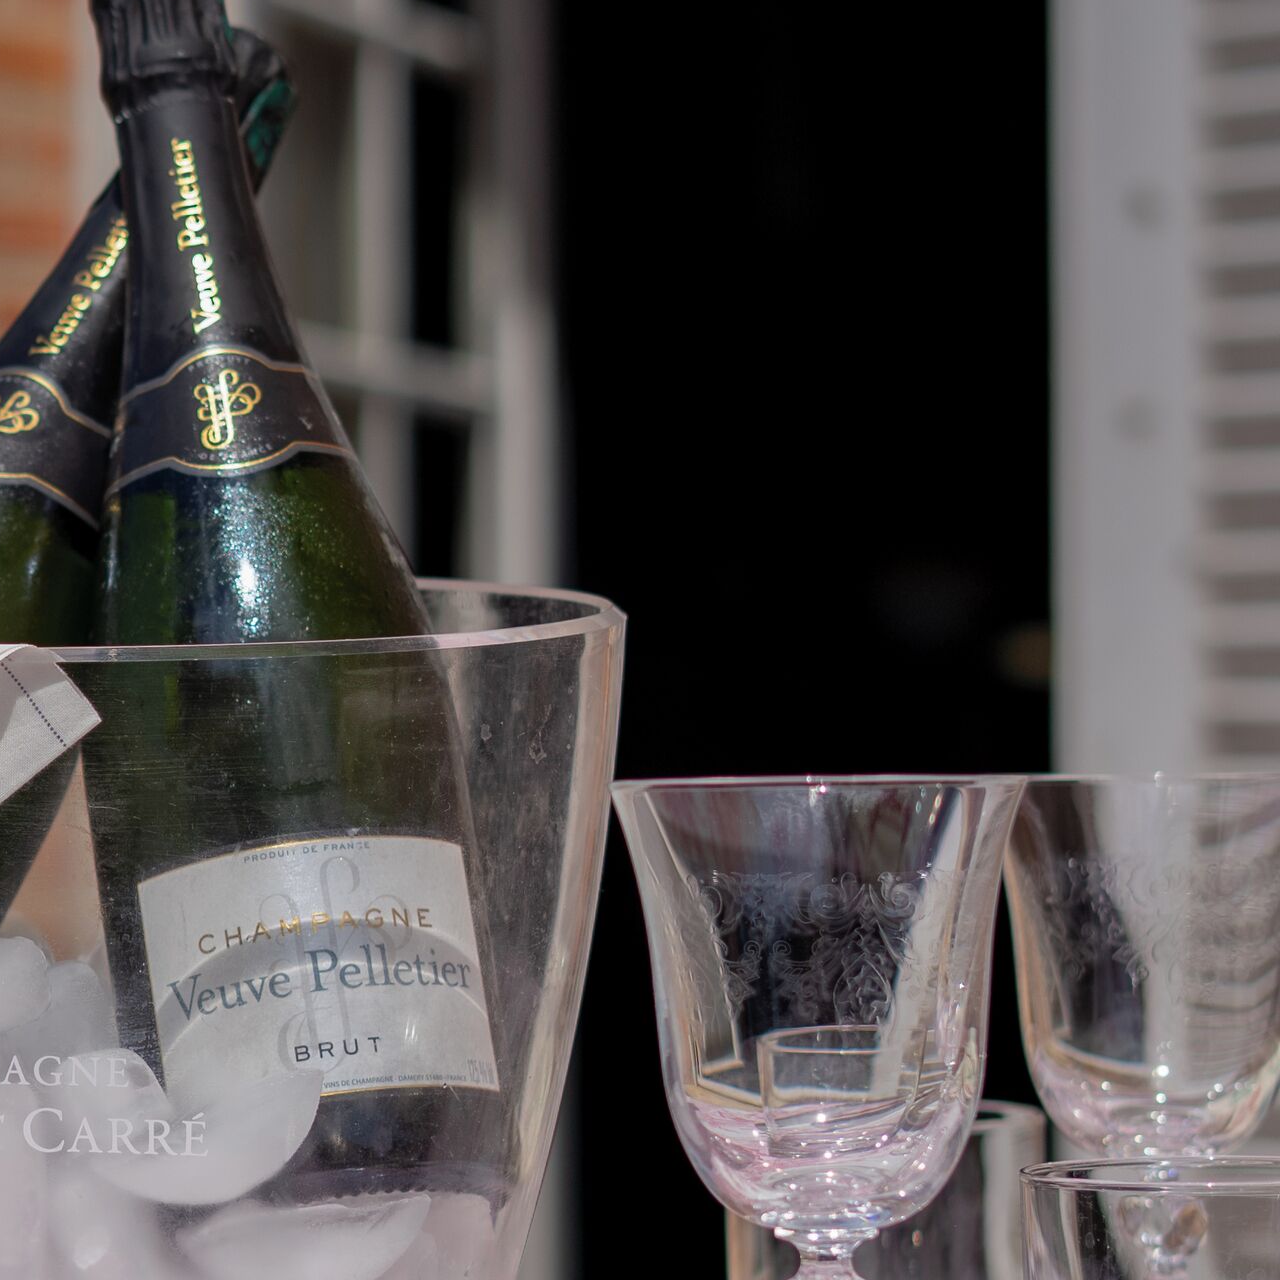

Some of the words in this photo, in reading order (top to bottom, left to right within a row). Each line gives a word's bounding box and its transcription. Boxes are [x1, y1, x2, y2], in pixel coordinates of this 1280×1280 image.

[169, 137, 209, 251] Pelletier
[192, 253, 221, 335] Veuve
[28, 293, 93, 356] Veuve
[244, 849, 296, 863] PRODUIT
[302, 845, 318, 854] DE
[323, 841, 370, 851] FRANCE
[198, 908, 433, 954] CHAMPAGNE
[169, 972, 292, 1021] Veuve
[304, 943, 472, 993] Pelletier
[294, 1036, 382, 1062] BRUT
[341, 1079, 350, 1087] DE
[21, 1105, 210, 1157] CARRÉ
